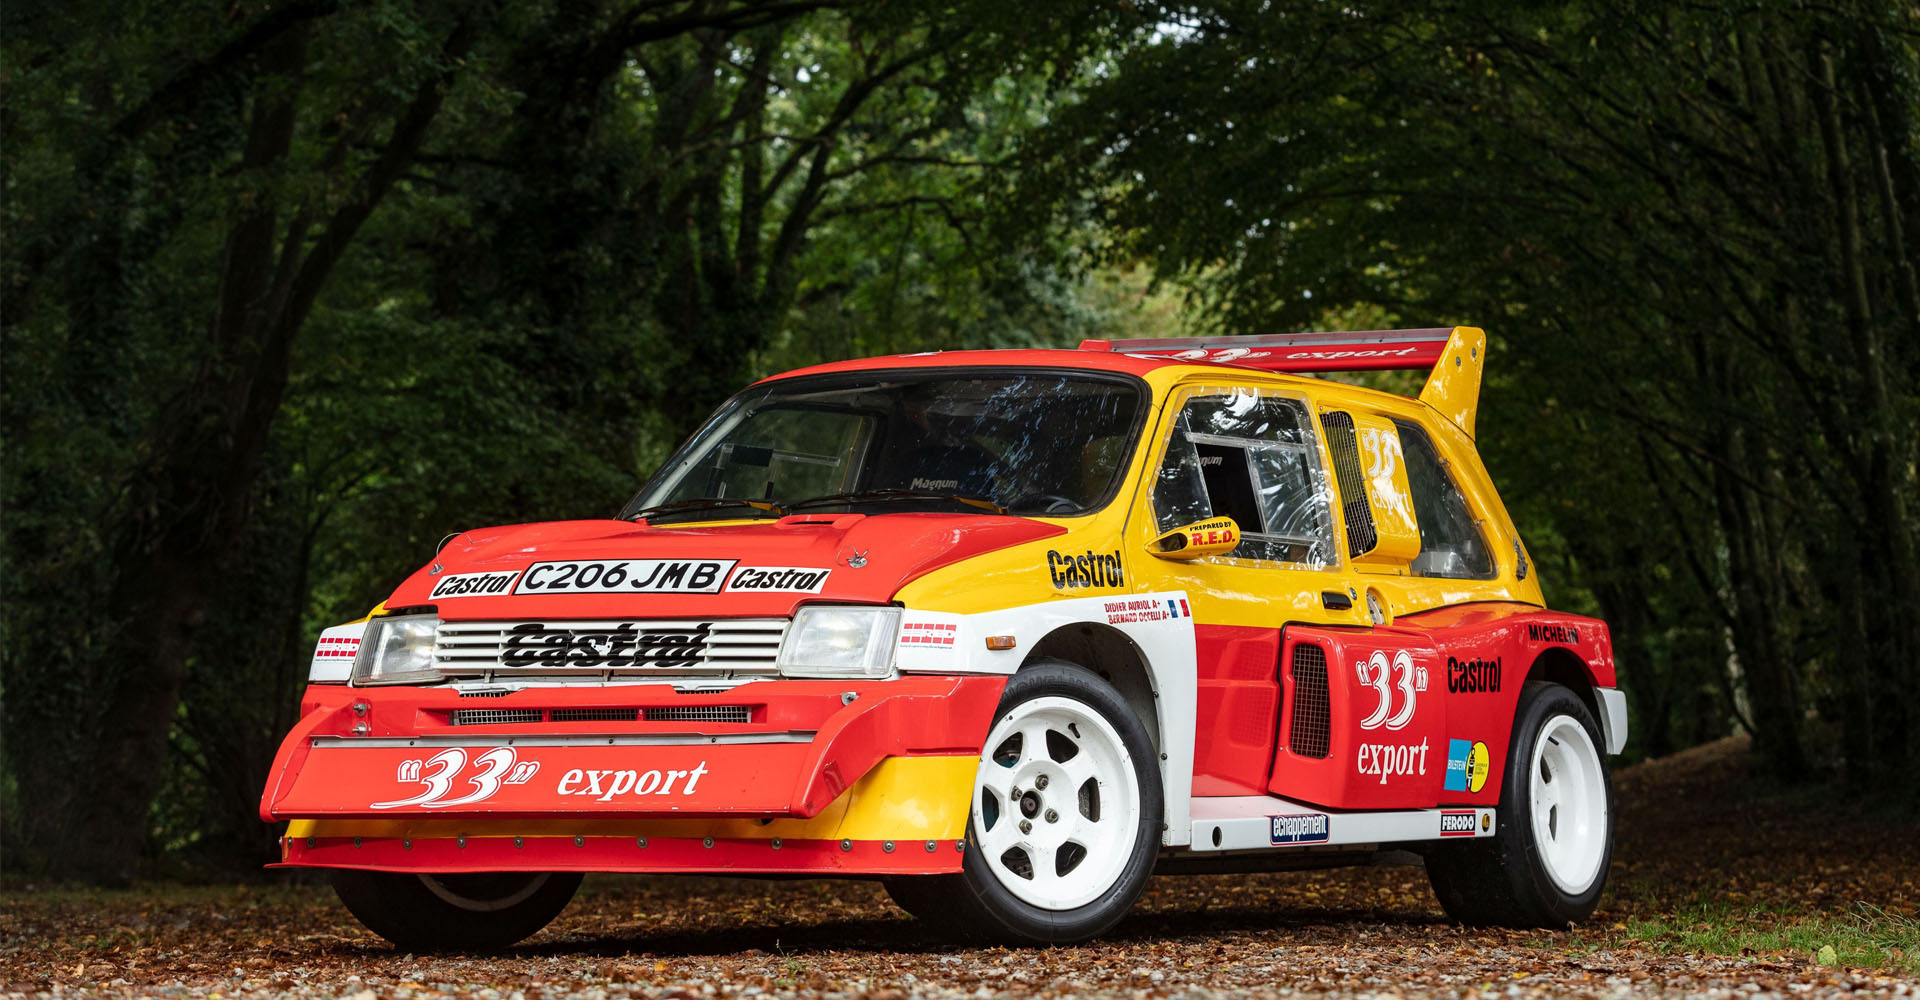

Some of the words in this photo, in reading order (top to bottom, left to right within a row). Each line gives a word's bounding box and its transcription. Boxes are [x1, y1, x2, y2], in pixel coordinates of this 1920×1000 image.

[1286, 346, 1419, 359] export
[909, 477, 959, 491] Magnum
[1189, 522, 1223, 531] PREPARED
[1192, 530, 1236, 546] R.E.D.
[525, 563, 630, 589] C206
[630, 563, 721, 589] JMB
[730, 568, 830, 590] Castrol
[1047, 550, 1124, 589] Castrol
[433, 572, 520, 597] Castrol
[1104, 602, 1127, 613] DIDIER
[1128, 600, 1151, 611] AURIOL
[1152, 599, 1161, 609] A+
[1107, 612, 1138, 625] BERNARD
[1162, 610, 1170, 620] A+
[1528, 624, 1579, 644] MICHELIN
[502, 623, 714, 667] Castrol
[1447, 656, 1501, 693] Castrol
[1357, 736, 1429, 784] export
[557, 760, 709, 801] export
[1442, 815, 1475, 830] FERODO
